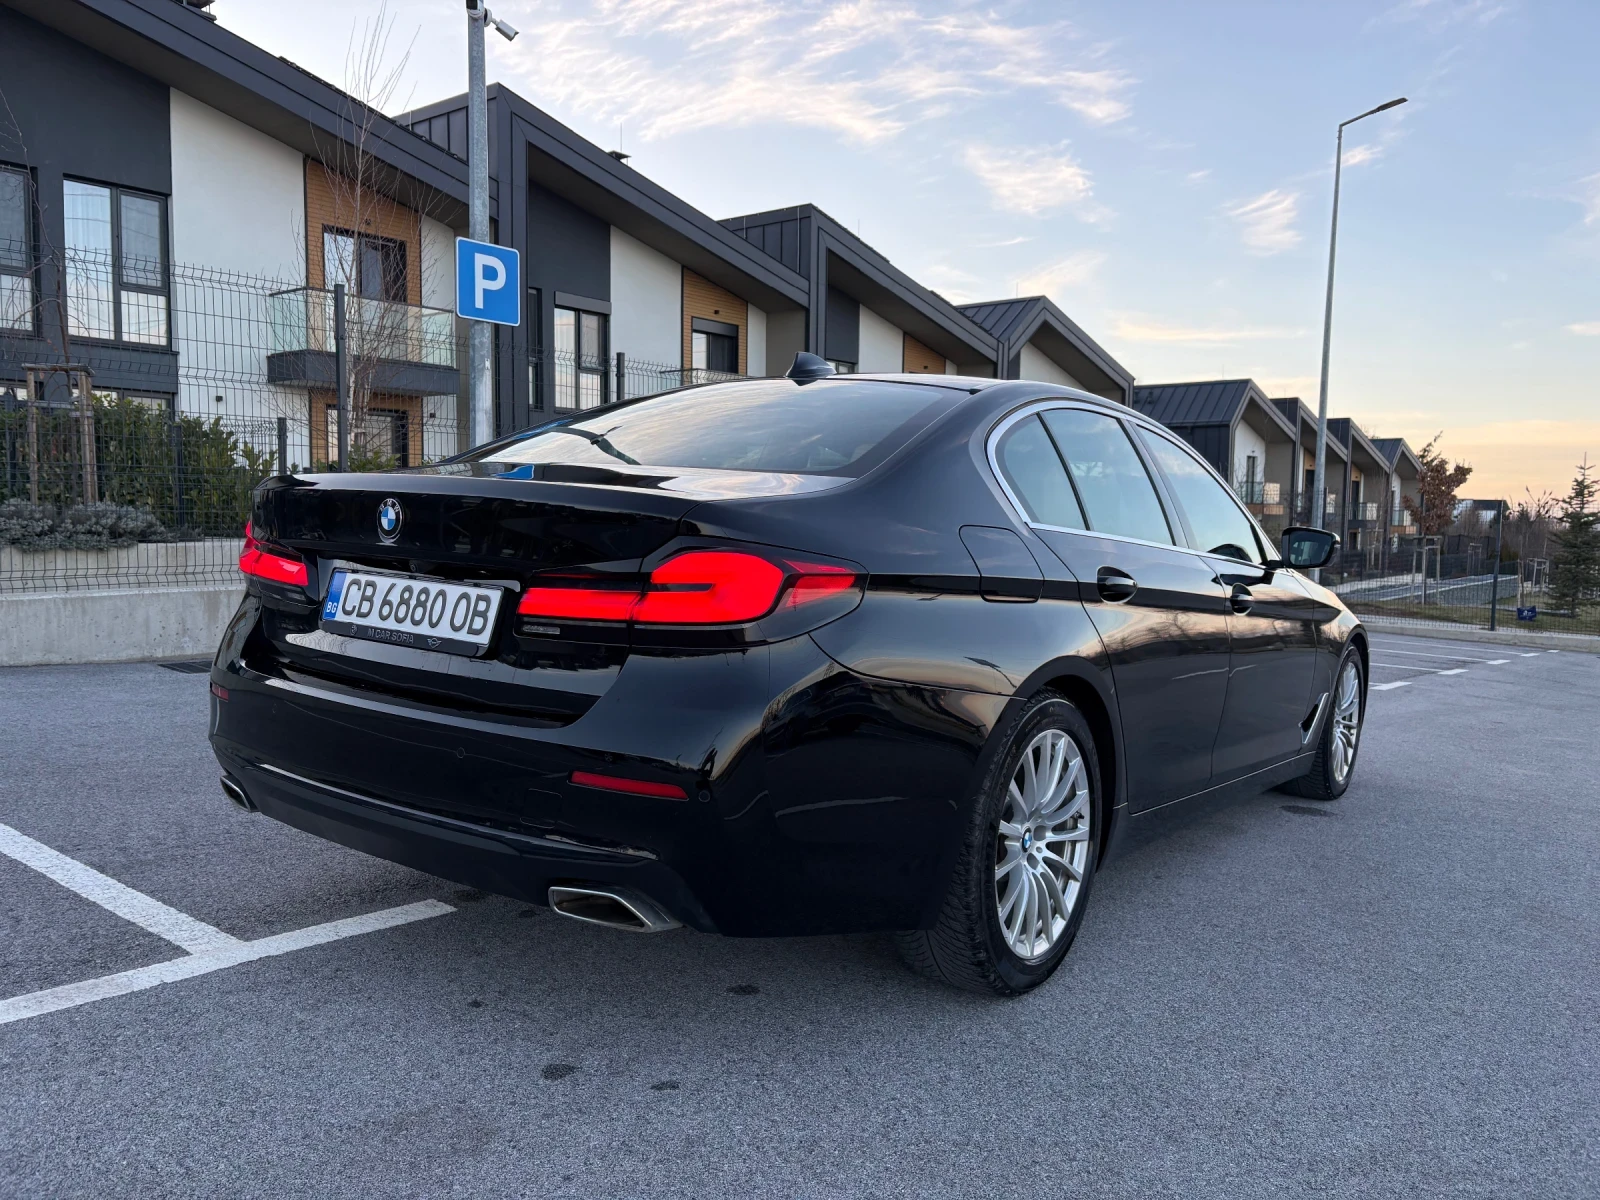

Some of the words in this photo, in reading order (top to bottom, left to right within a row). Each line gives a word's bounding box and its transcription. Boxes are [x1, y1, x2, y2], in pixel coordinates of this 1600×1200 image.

[474, 252, 507, 310] P
[379, 499, 400, 513] BMW
[326, 601, 338, 614] BG
[342, 578, 378, 618] CB
[378, 582, 447, 629] 6880
[450, 591, 492, 636] OB
[367, 628, 375, 638] M
[375, 629, 391, 640] CAR
[391, 632, 414, 644] SOFIA
